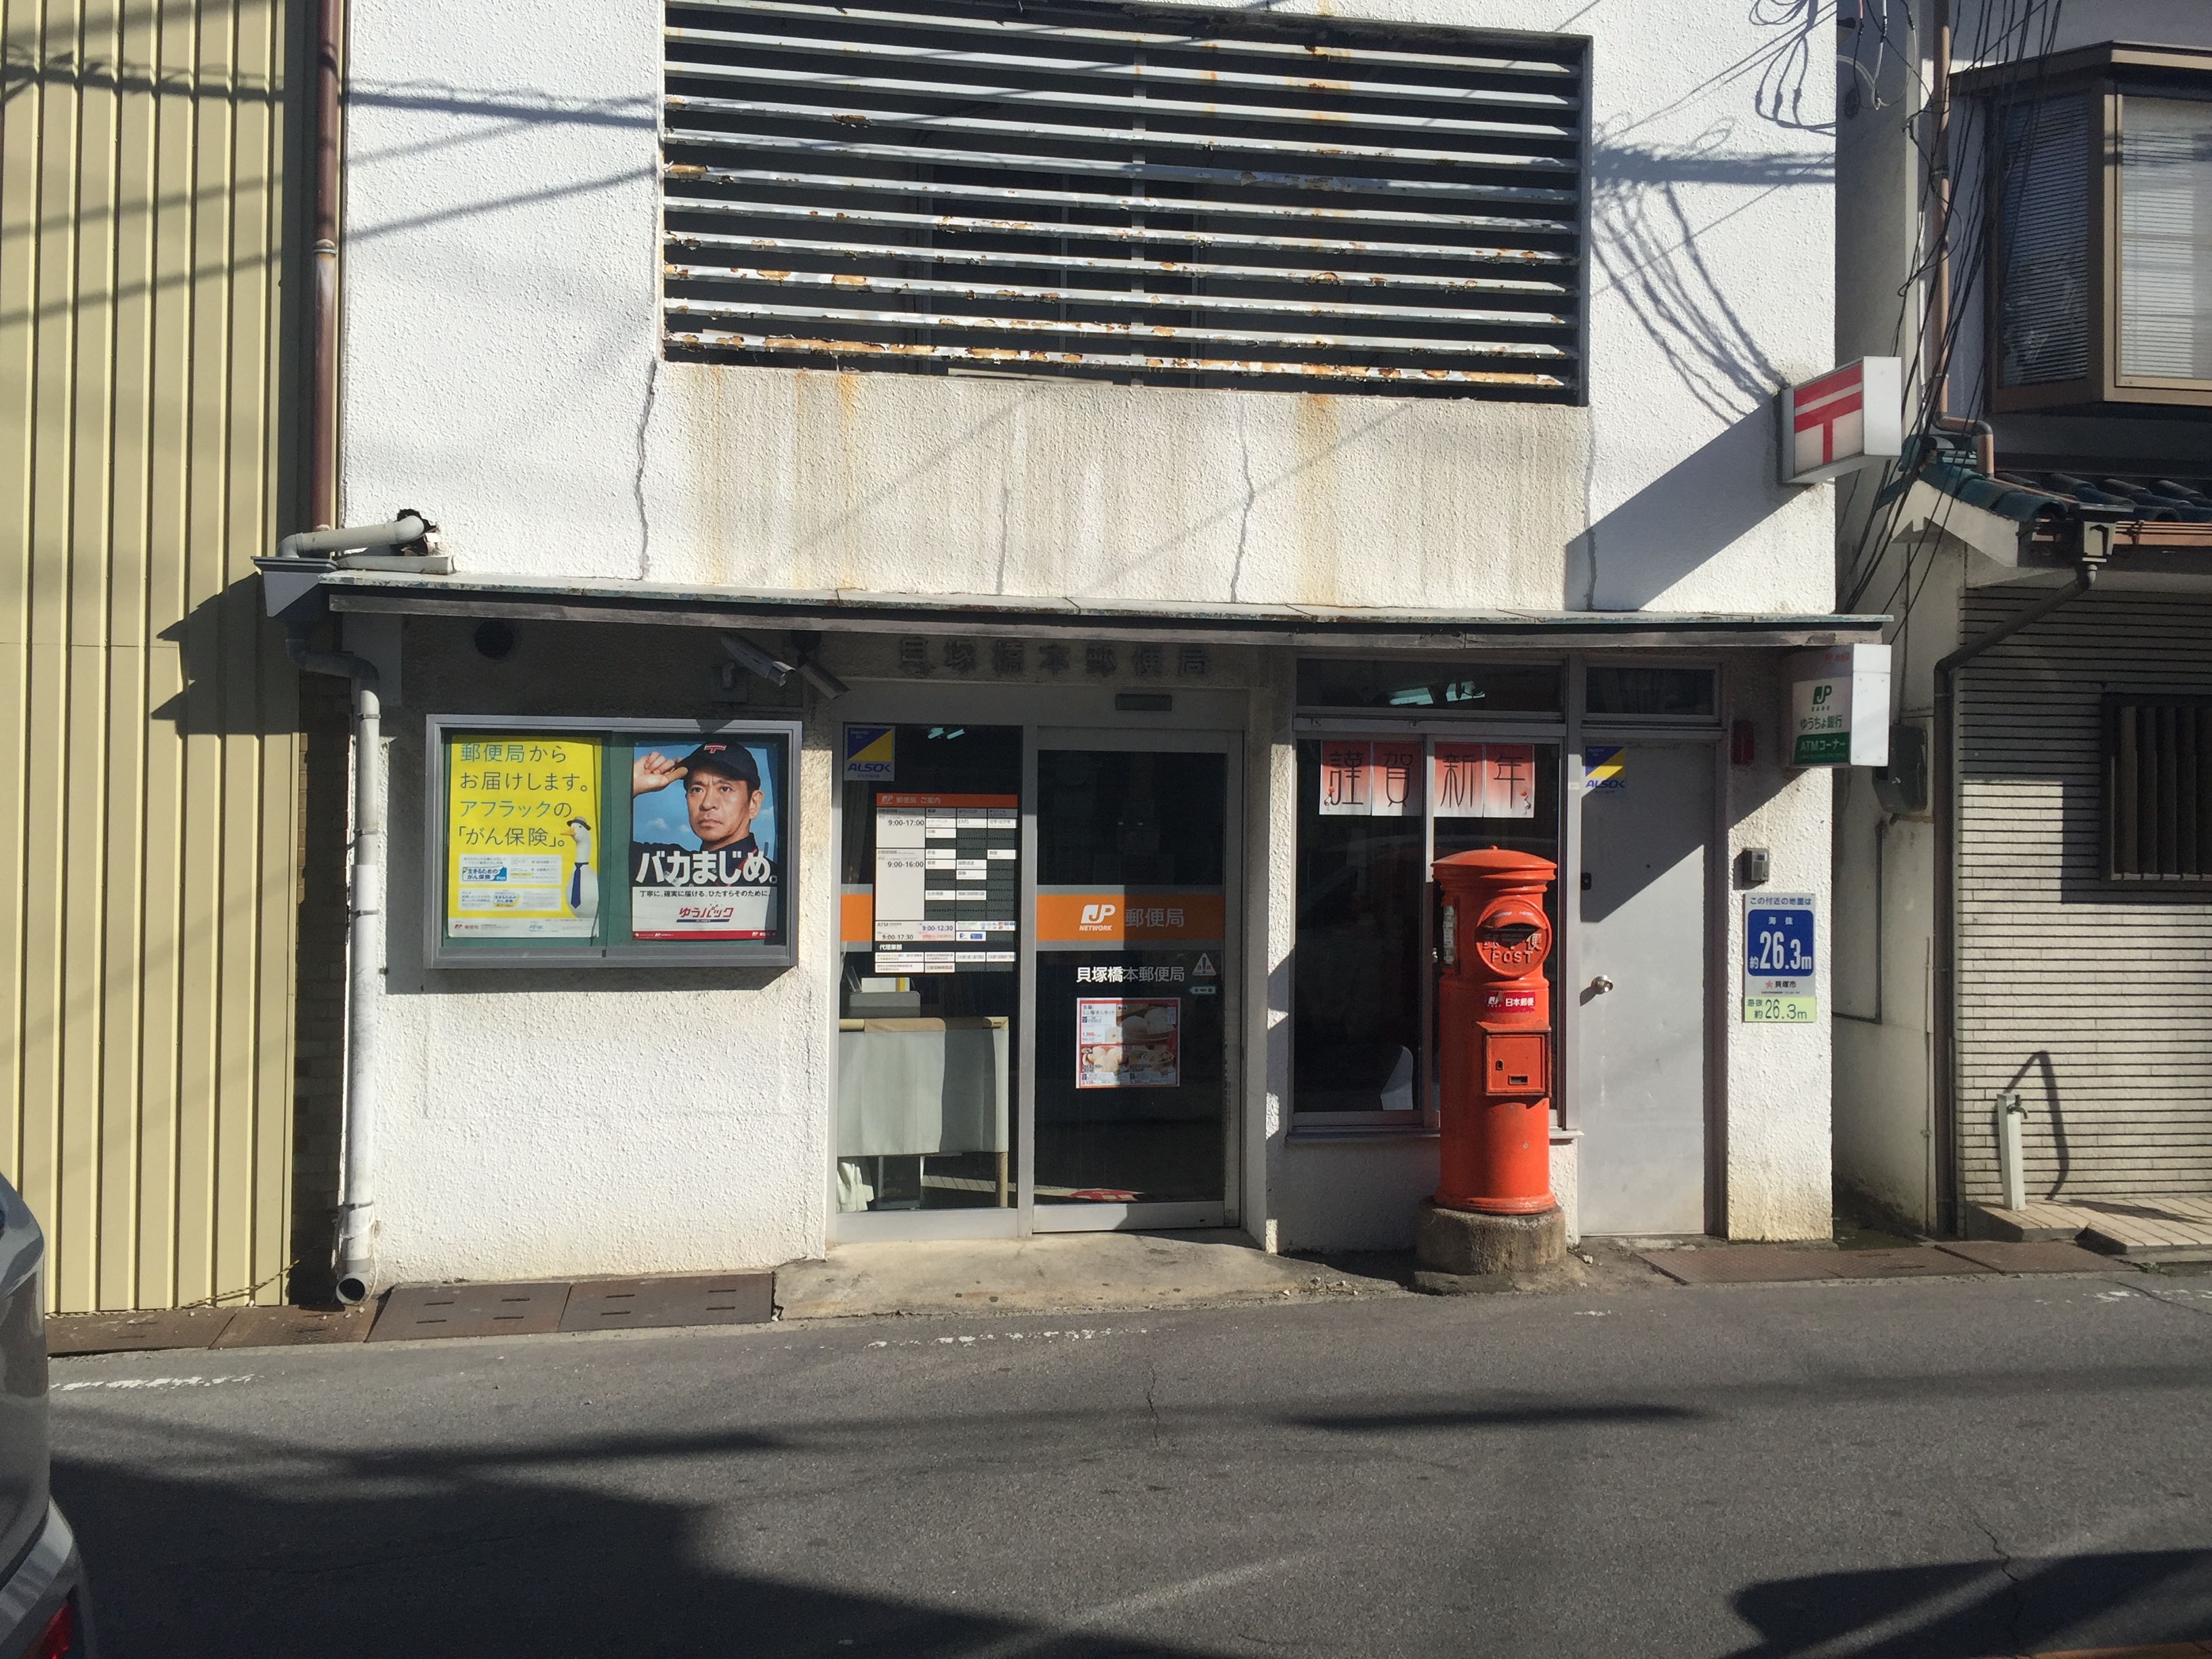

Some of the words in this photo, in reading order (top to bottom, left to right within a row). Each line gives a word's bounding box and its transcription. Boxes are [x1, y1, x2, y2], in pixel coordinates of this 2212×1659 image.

[1800, 715, 1843, 730] ゆうちょ銀行
[460, 743, 566, 763] 郵便局から
[1800, 739, 1846, 752] ATMコーナー
[847, 763, 891, 773] ALSOK
[460, 772, 588, 792] お届けします。
[1330, 750, 1527, 810] 謹賀新年
[1586, 780, 1625, 789] ALSOK
[460, 800, 572, 818] アフラックの
[459, 826, 565, 847] 「がん保険」。
[636, 851, 778, 884] バカまじめ。
[679, 906, 734, 918] ゆうパック
[1081, 904, 1115, 924] JP
[1126, 908, 1185, 928] 郵便局
[1492, 950, 1534, 963] POST
[1076, 966, 1185, 983] 貝塚橋本郵便局
[1505, 998, 1534, 1006] 日本郵便
